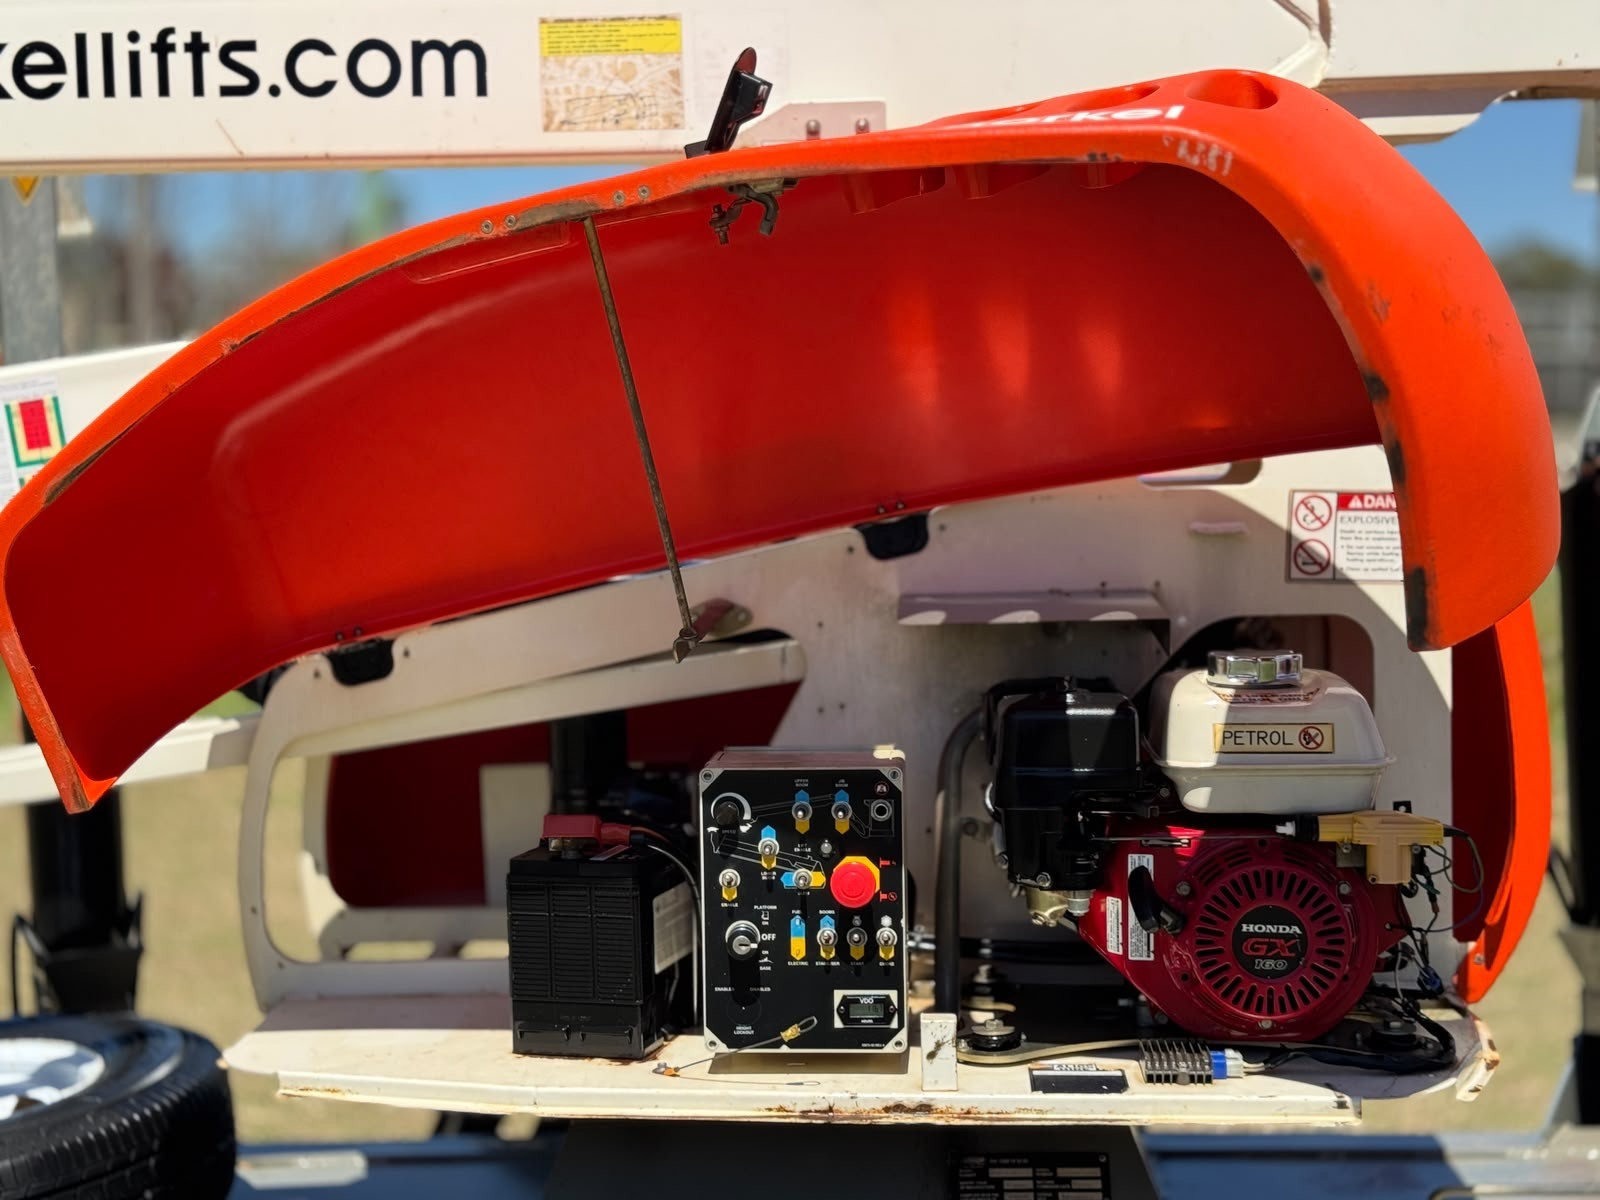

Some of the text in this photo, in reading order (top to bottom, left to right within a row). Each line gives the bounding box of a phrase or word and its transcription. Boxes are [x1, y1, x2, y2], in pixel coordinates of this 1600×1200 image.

[1222, 730, 1293, 746] PETROL
[1241, 923, 1303, 934] HONDA
[761, 933, 777, 941] OFF
[1242, 937, 1297, 957] GX
[1254, 959, 1288, 970] 160
[859, 996, 874, 1004] VDO
